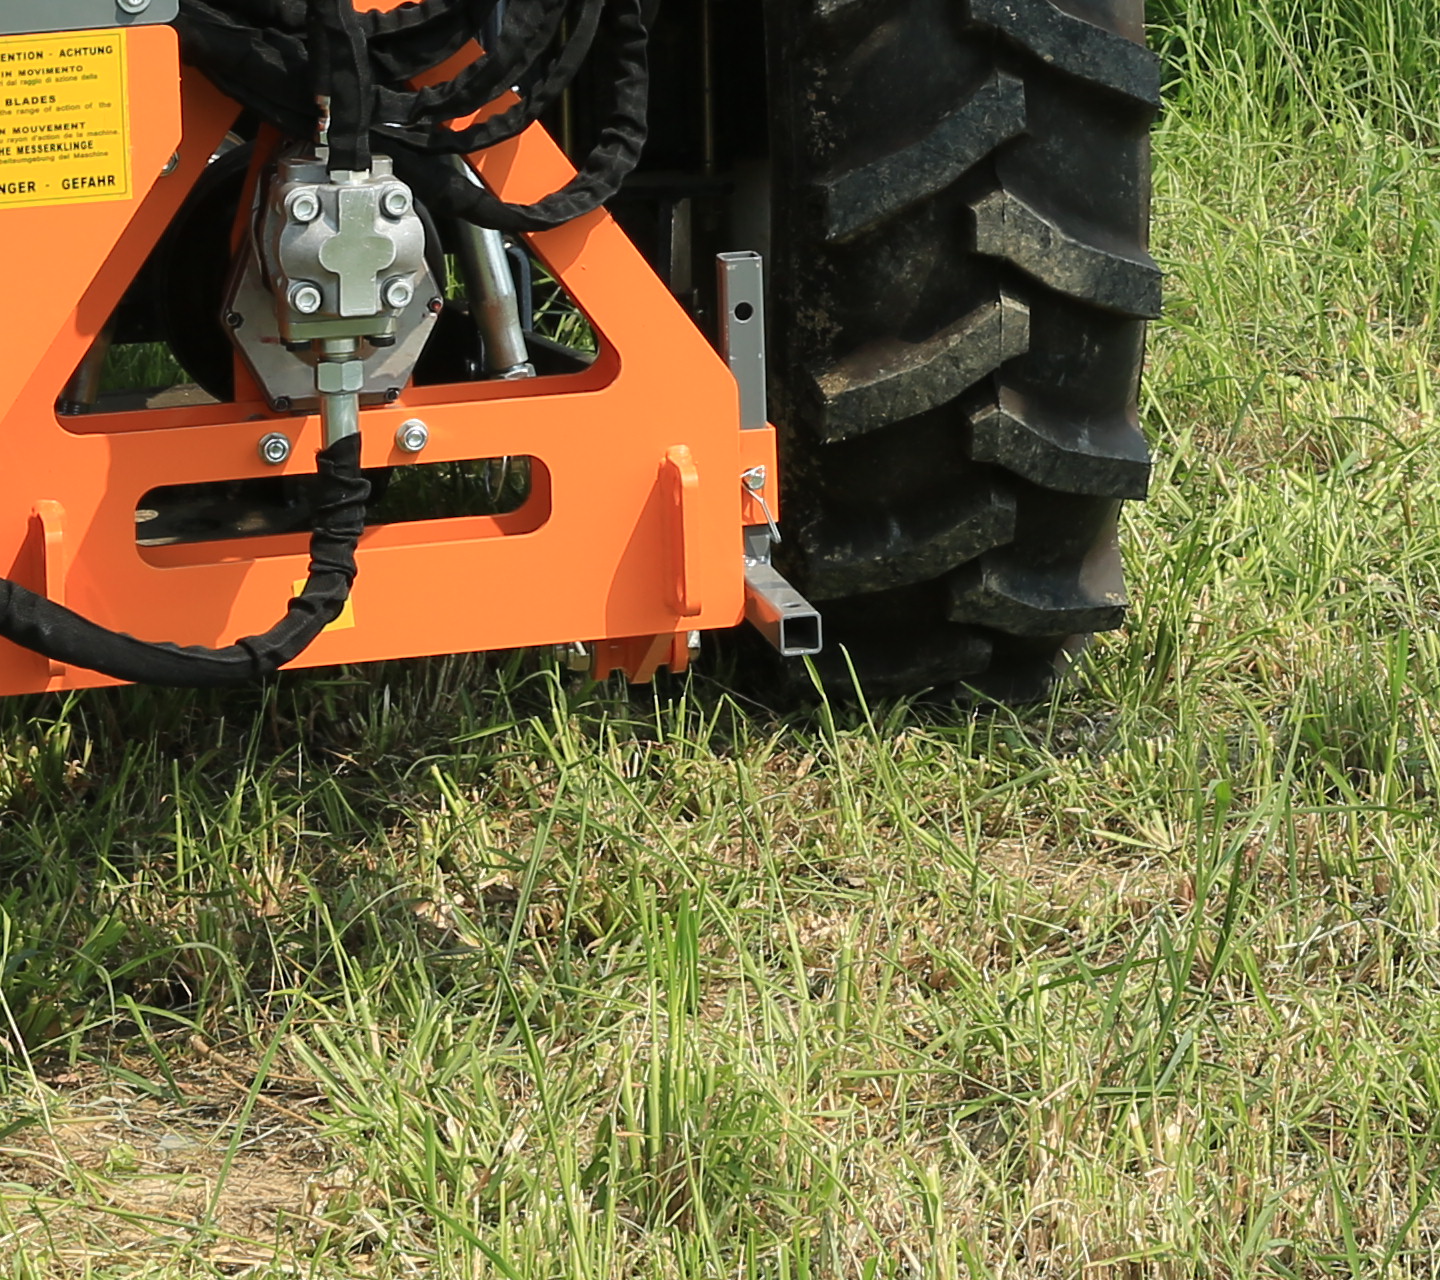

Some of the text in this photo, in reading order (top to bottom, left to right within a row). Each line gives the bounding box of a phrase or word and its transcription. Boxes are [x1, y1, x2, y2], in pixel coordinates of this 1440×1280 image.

[59, 45, 113, 58] ACHTUNG
[1, 70, 12, 78] IN
[18, 65, 83, 76] MOVIMENTO
[5, 95, 56, 107] BLADES
[16, 108, 40, 116] range
[43, 105, 52, 113] of
[56, 104, 81, 112] action
[84, 102, 93, 110] of
[98, 101, 112, 109] the
[12, 121, 86, 134] MOUVEMENT
[17, 140, 94, 155] MESSERKLINGE
[61, 174, 116, 190] GEFAHR
